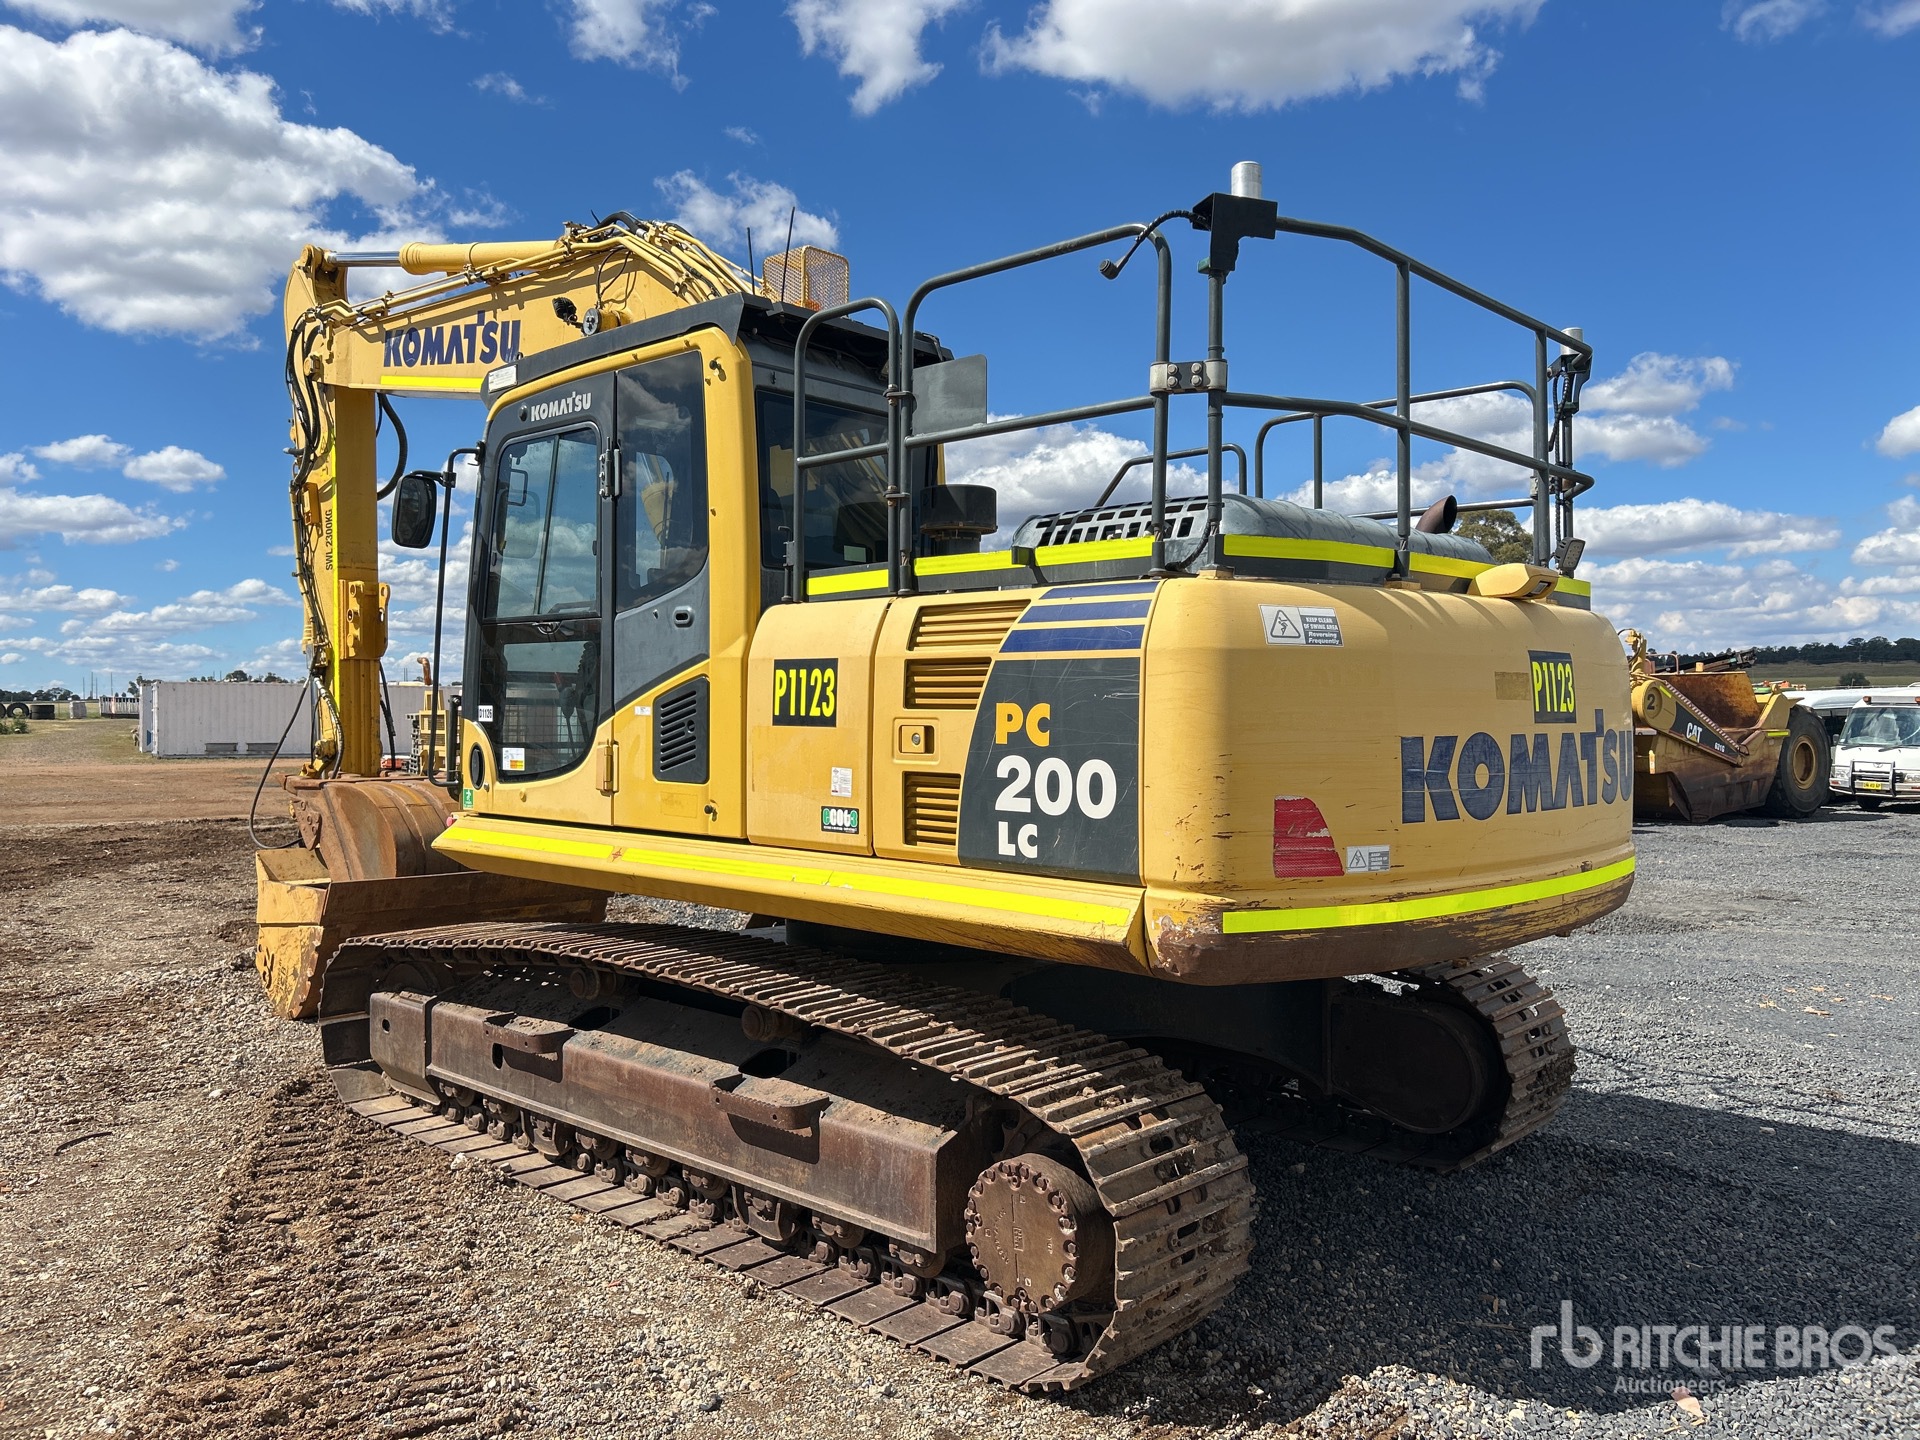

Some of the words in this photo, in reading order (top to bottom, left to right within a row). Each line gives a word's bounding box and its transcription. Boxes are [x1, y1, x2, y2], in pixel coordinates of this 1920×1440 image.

[383, 310, 521, 368] KOMATSU
[530, 391, 592, 422] KOMATSU
[325, 509, 333, 547] 2300KG
[325, 550, 333, 571] SWL
[1308, 631, 1338, 639] Reversing
[1308, 637, 1340, 645] Frequently
[773, 667, 836, 718] P1123
[1531, 661, 1575, 713] P1123
[1647, 693, 1656, 710] 2
[995, 702, 1051, 747] PC
[1686, 722, 1703, 743] CAT
[1400, 708, 1633, 825] KOMATSU
[994, 754, 1117, 820] 200
[998, 820, 1038, 859] LC
